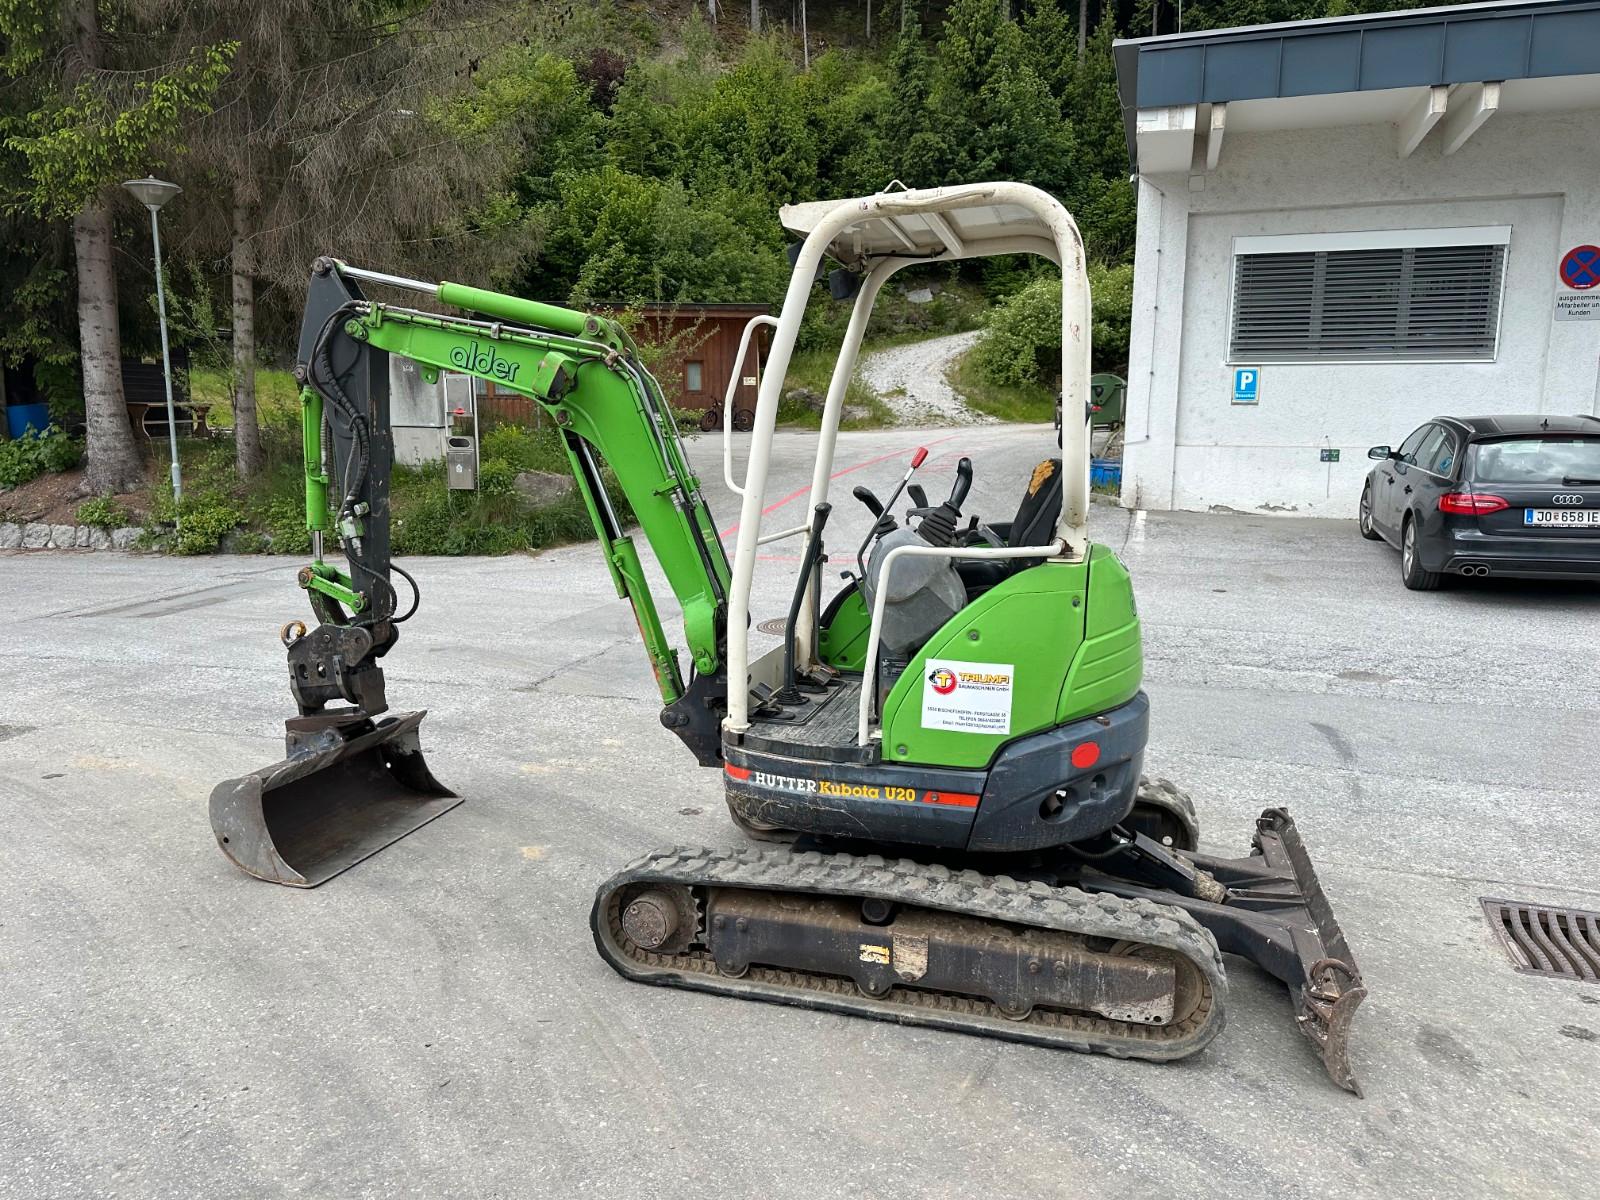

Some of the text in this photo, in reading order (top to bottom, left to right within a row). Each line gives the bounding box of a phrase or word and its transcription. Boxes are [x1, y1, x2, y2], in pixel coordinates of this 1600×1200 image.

[450, 341, 520, 382] alder
[1240, 371, 1254, 390] P
[1537, 511, 1552, 522] JO
[1561, 511, 1584, 522] 658
[755, 771, 916, 802] HUTTER Kubota U20
